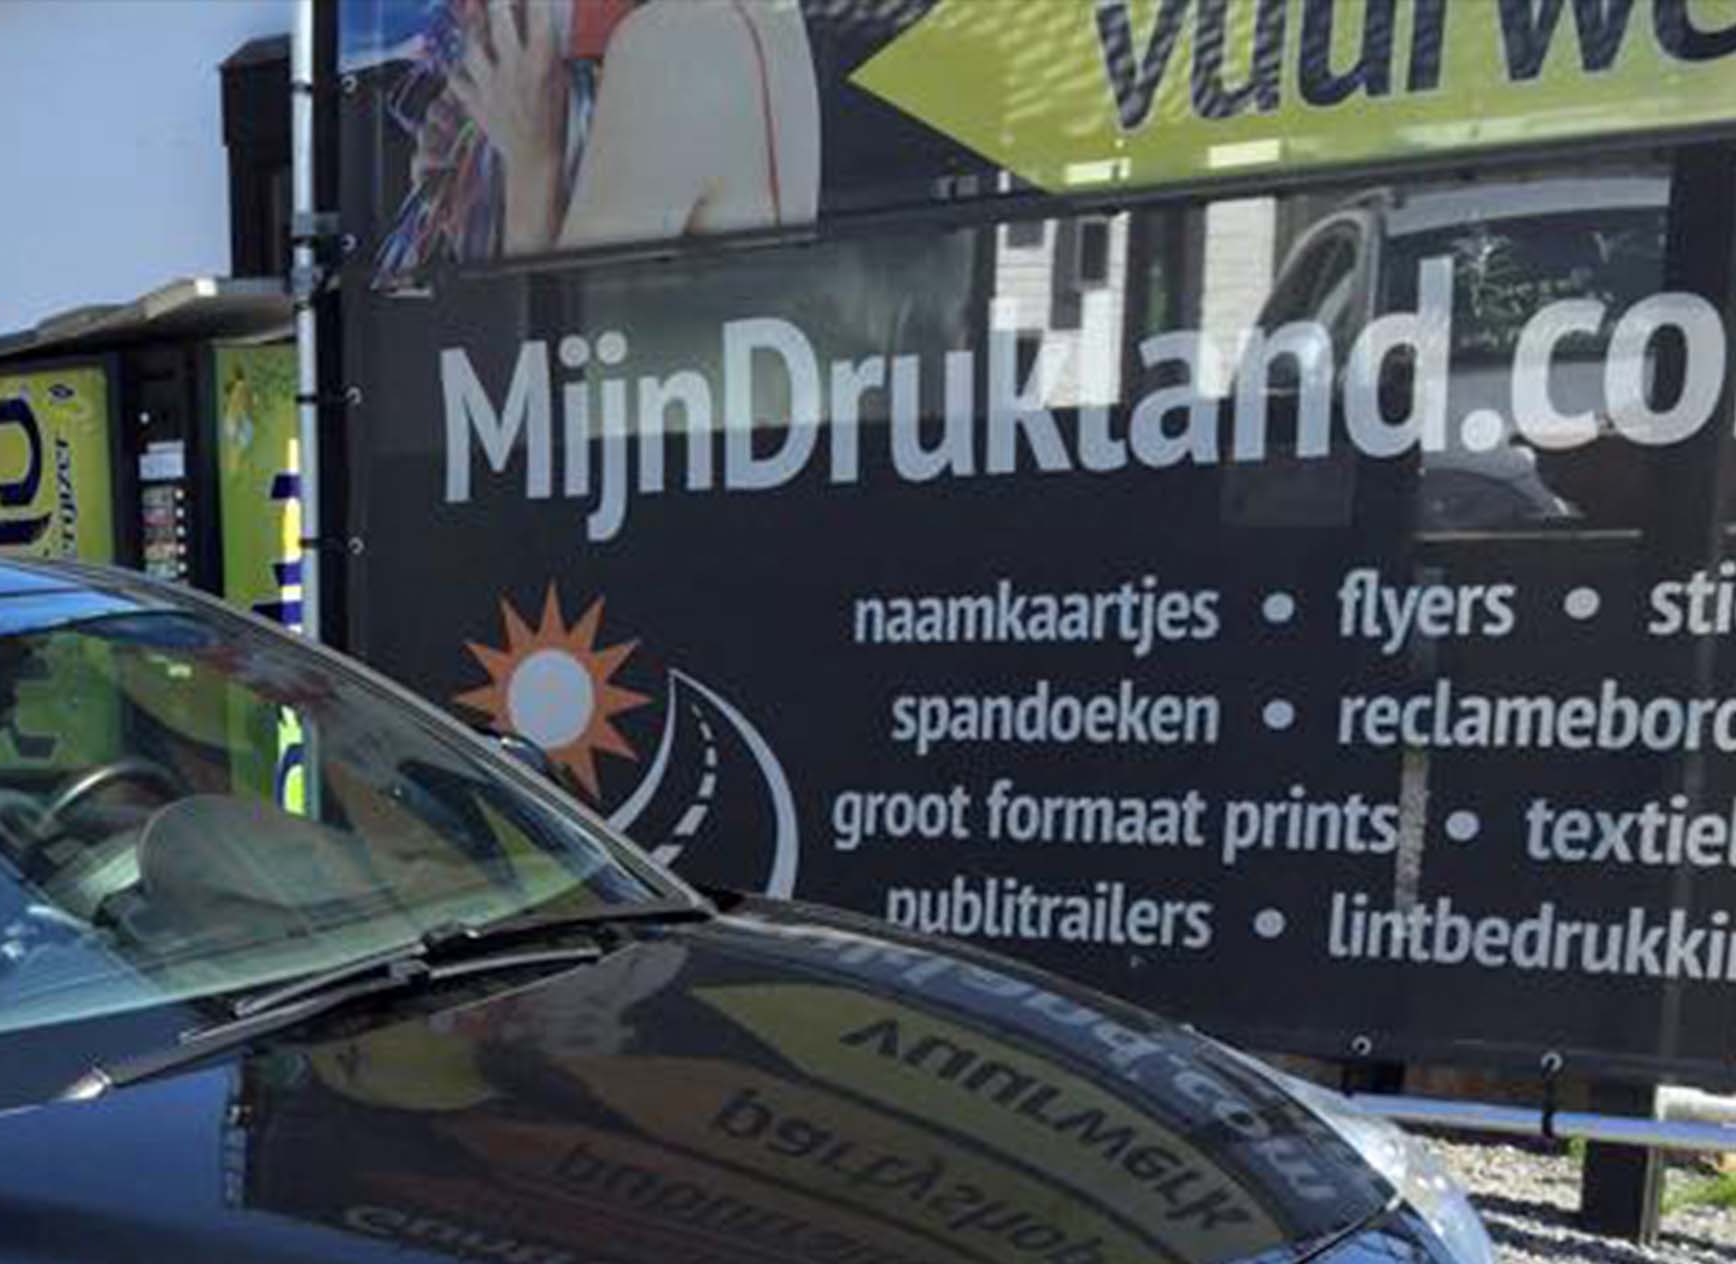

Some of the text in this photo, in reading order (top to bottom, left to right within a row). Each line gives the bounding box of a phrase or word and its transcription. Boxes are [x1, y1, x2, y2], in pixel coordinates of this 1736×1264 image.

[439, 257, 1736, 541] MijnDrukland.co
[855, 560, 1736, 656] naamkaartjes flyers sti
[891, 682, 1220, 753] spandoeken
[833, 785, 970, 850] groot
[986, 780, 1205, 847] formaat
[1224, 785, 1398, 862] prints
[886, 877, 1212, 948] publitrailers
